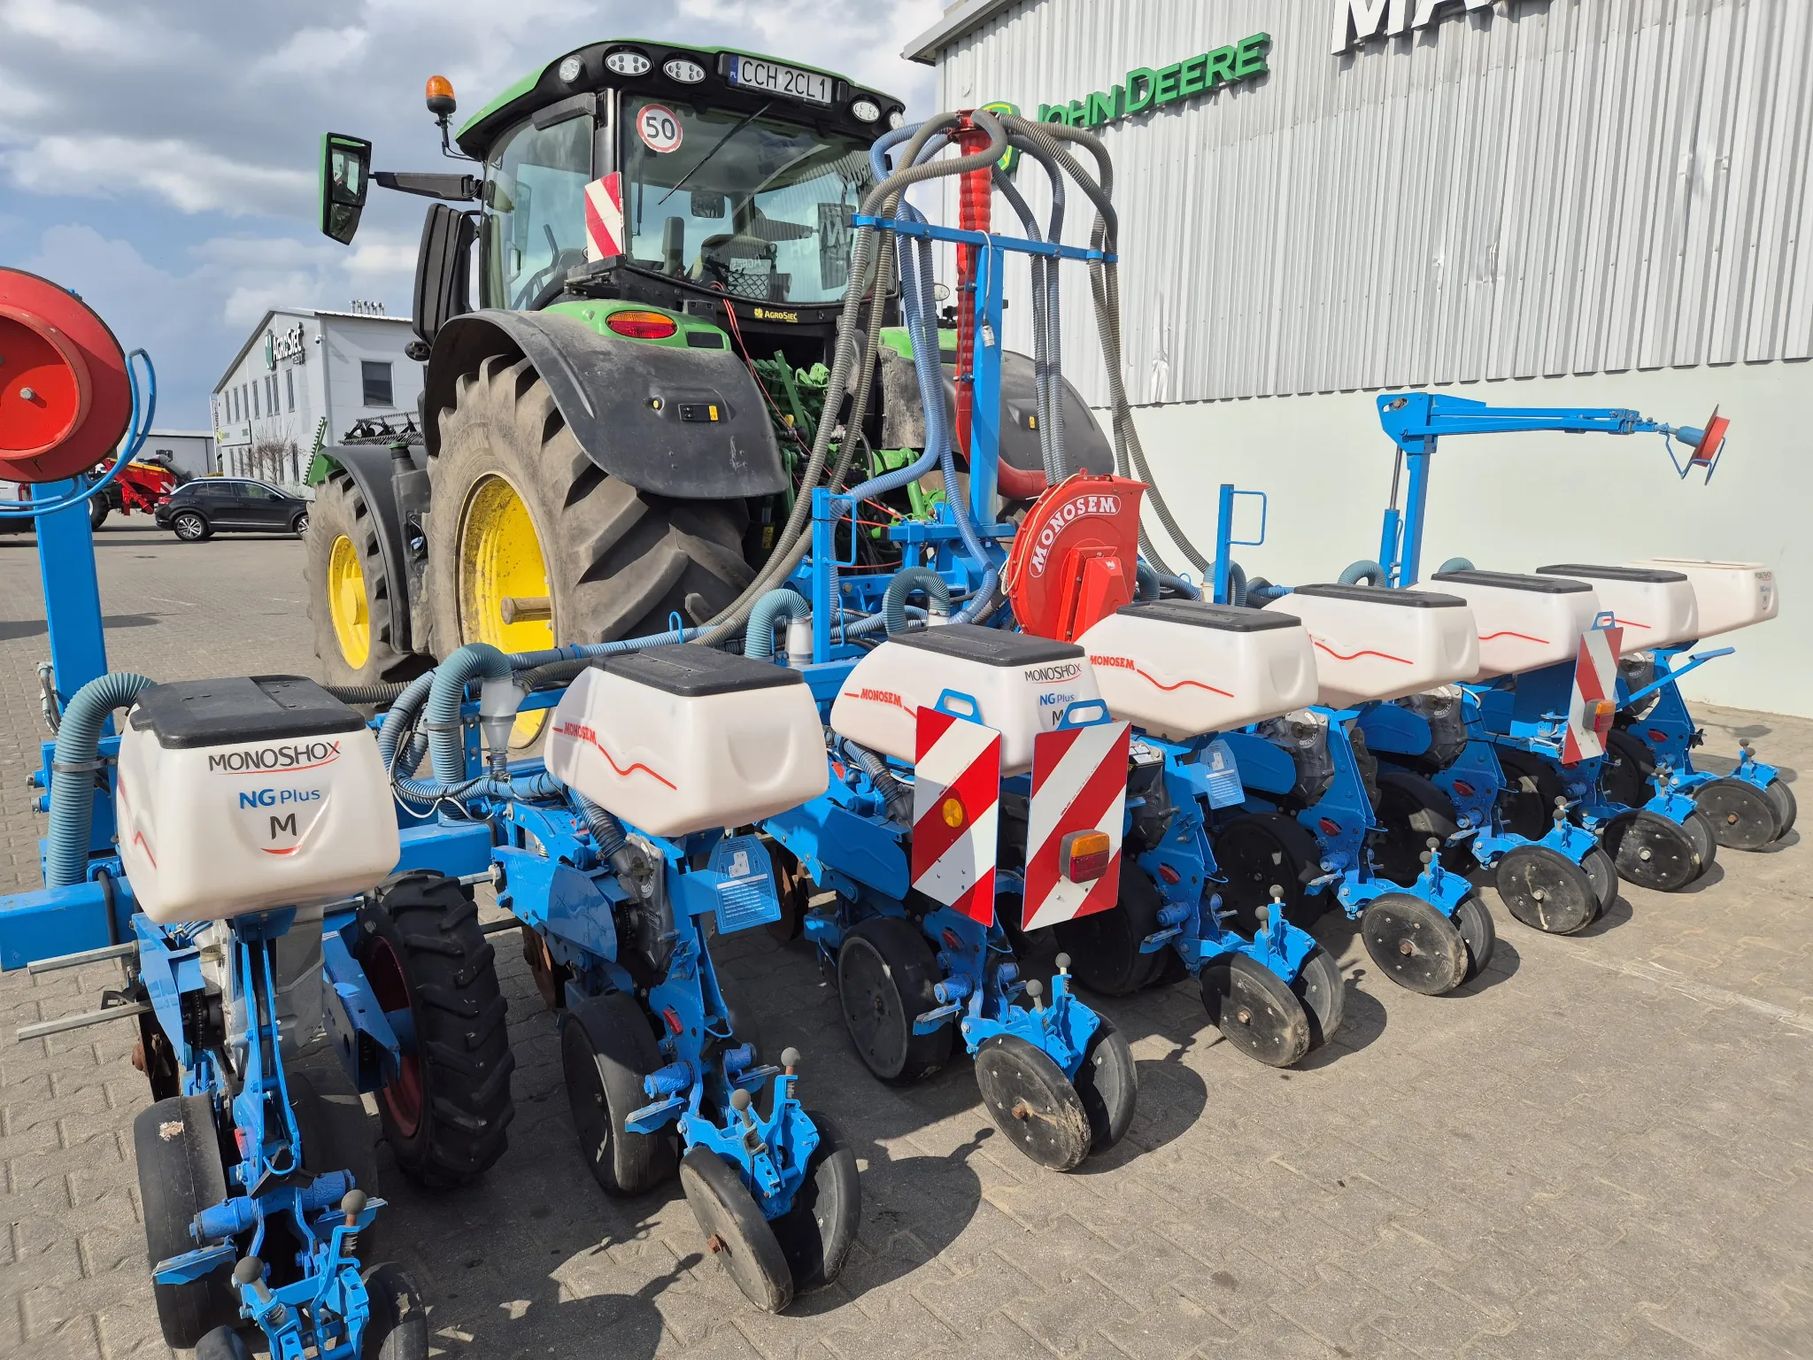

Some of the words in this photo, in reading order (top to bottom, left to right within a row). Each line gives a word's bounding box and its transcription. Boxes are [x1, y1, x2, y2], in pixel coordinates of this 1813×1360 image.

[742, 60, 778, 89] CCH
[783, 70, 826, 100] 2CL1
[1124, 31, 1270, 113] DEERE
[646, 116, 676, 141] 50
[1031, 496, 1116, 573] MONOSEM
[1024, 662, 1082, 682] MONOSHOX
[1090, 655, 1136, 670] MONOSEM
[860, 688, 903, 708] MONOSEM
[1039, 693, 1056, 706] NG
[564, 721, 598, 746] MONOSEM
[208, 740, 341, 772] MONOSHOX
[239, 788, 276, 809] NG
[270, 813, 298, 840] M
